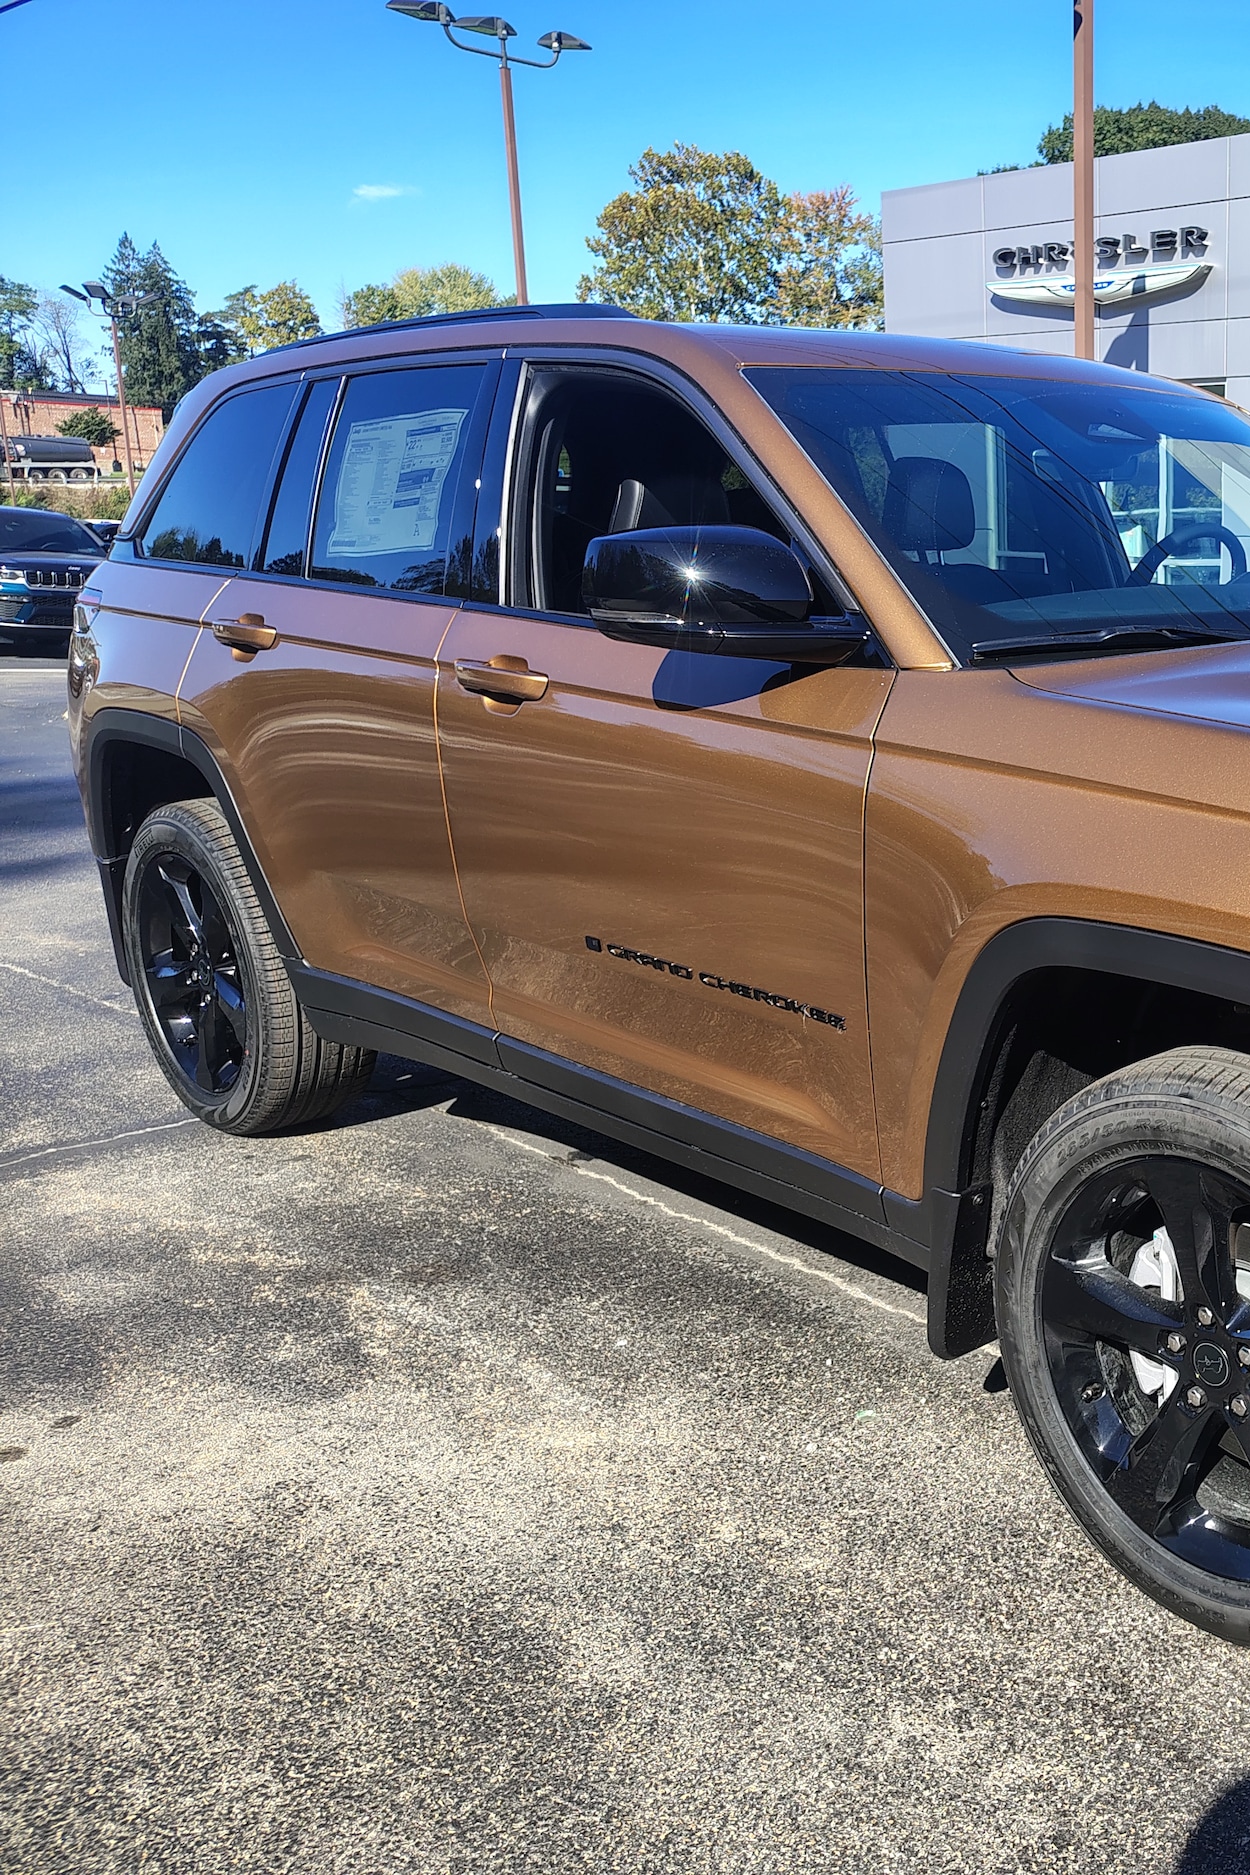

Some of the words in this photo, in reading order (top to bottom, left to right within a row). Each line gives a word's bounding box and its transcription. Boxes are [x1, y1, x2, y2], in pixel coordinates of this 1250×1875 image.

[992, 225, 1209, 267] CHRSLER
[606, 943, 693, 980] GRAND
[698, 971, 847, 1031] CHEROKEE
